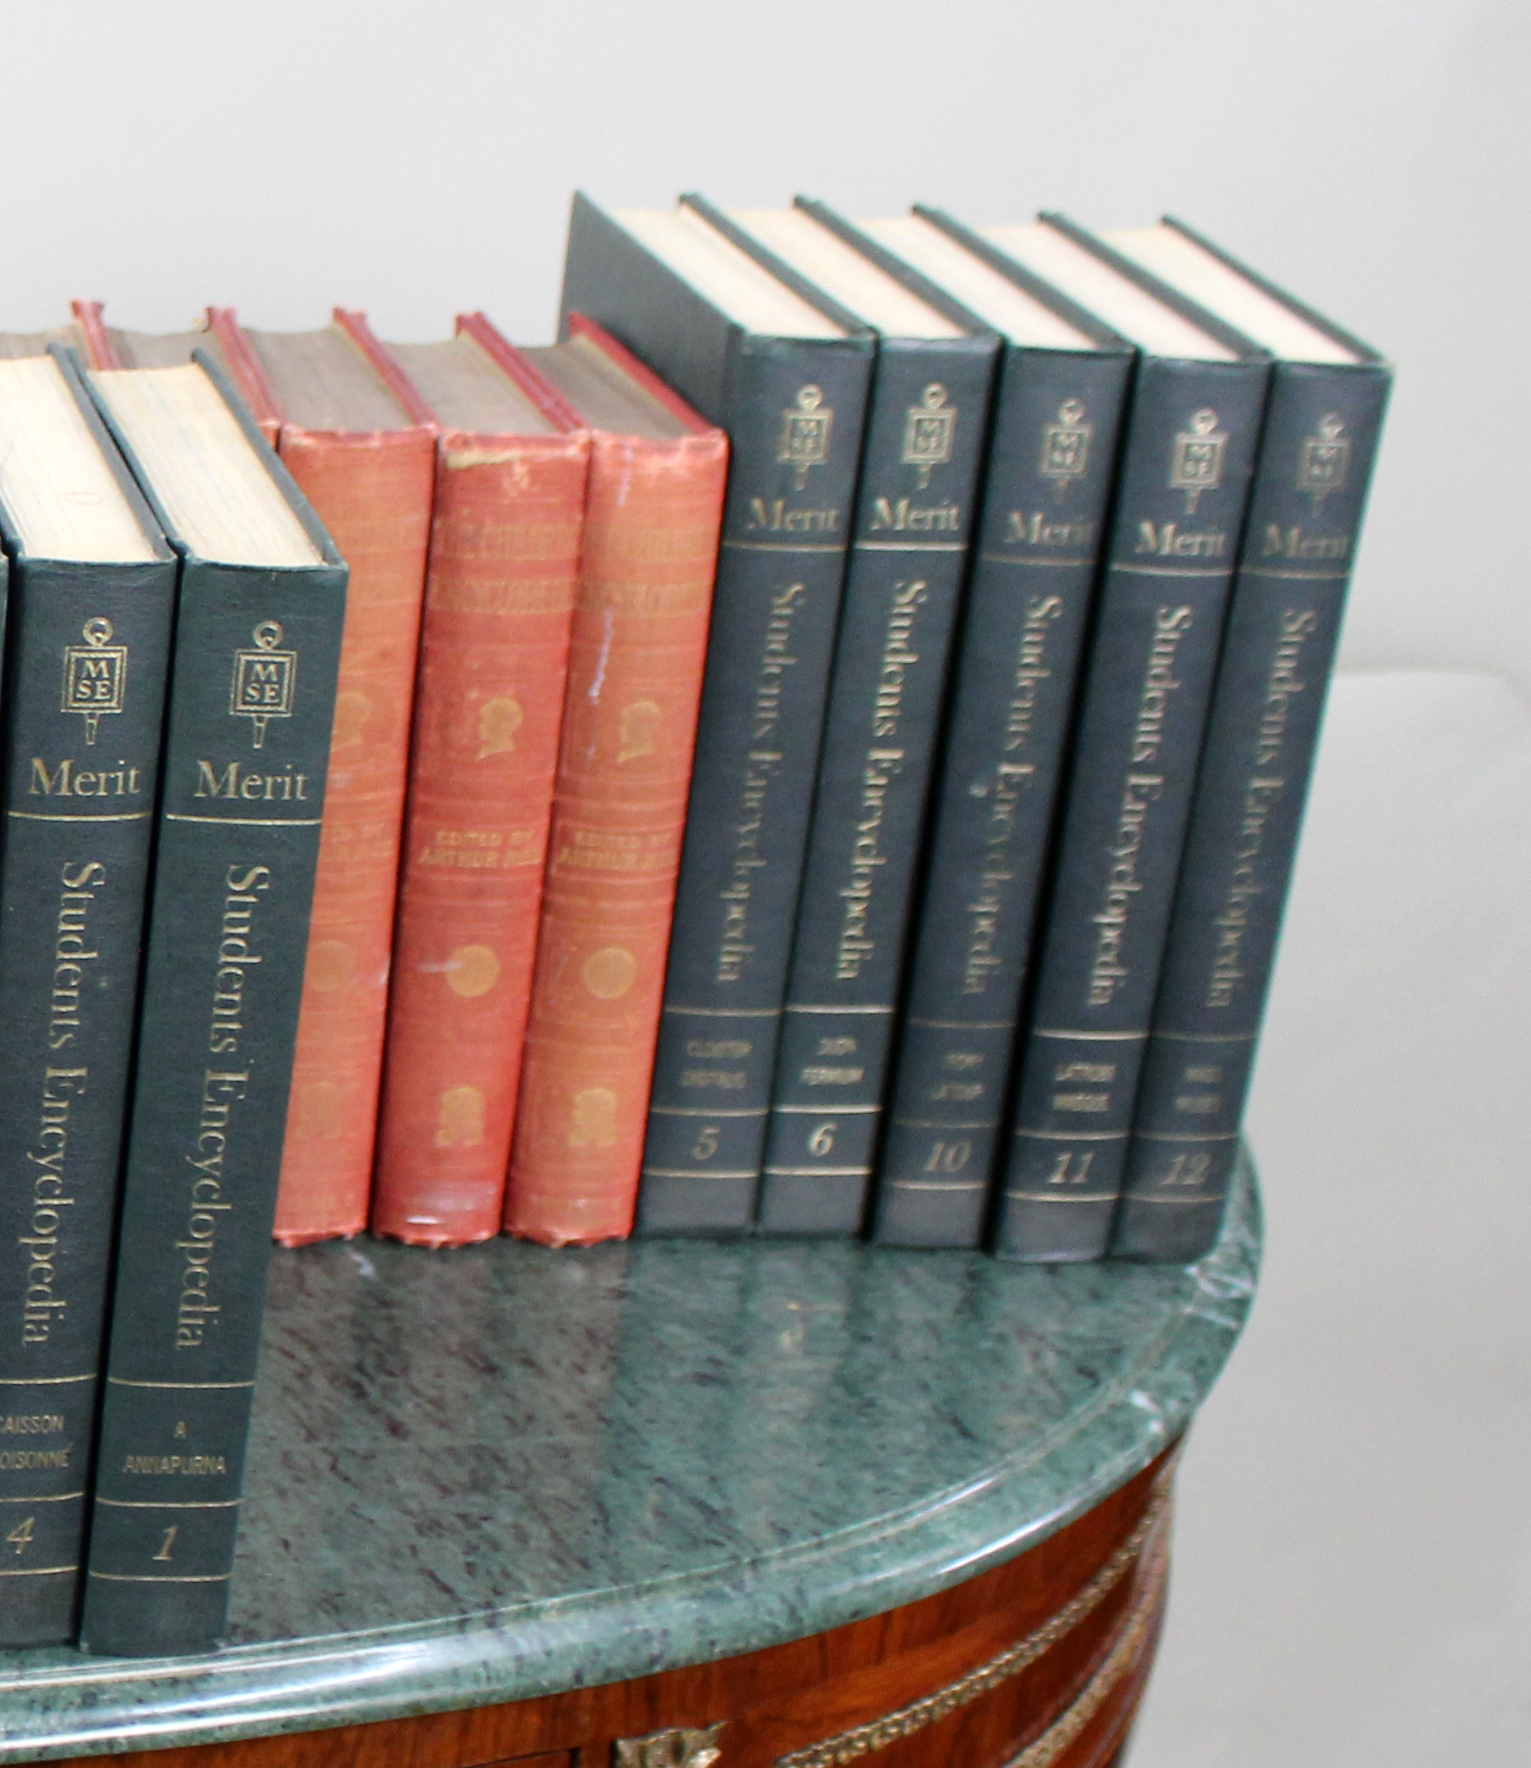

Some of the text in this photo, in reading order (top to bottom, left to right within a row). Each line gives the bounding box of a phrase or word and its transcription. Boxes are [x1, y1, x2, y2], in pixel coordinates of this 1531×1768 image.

[870, 497, 960, 531] Merit
[81, 659, 110, 678] M
[250, 663, 279, 682] M
[874, 580, 927, 737] Students
[76, 680, 113, 700] SE
[245, 683, 280, 703] SE
[1133, 604, 1193, 763] Students
[28, 757, 141, 796] Merit
[193, 760, 311, 800] Merit
[18, 860, 106, 1348] Students Encyclopedia
[175, 864, 271, 1351] Students Encyclopedia
[692, 1127, 721, 1160] 5
[809, 1123, 837, 1158] 6
[923, 1141, 972, 1173] 10
[1047, 1153, 1094, 1184] 11
[1161, 1154, 1212, 1185] 12
[174, 1420, 187, 1439] A
[123, 1455, 226, 1476] ANNAPURNA
[6, 1516, 35, 1555] 4
[151, 1525, 180, 1561] 1
